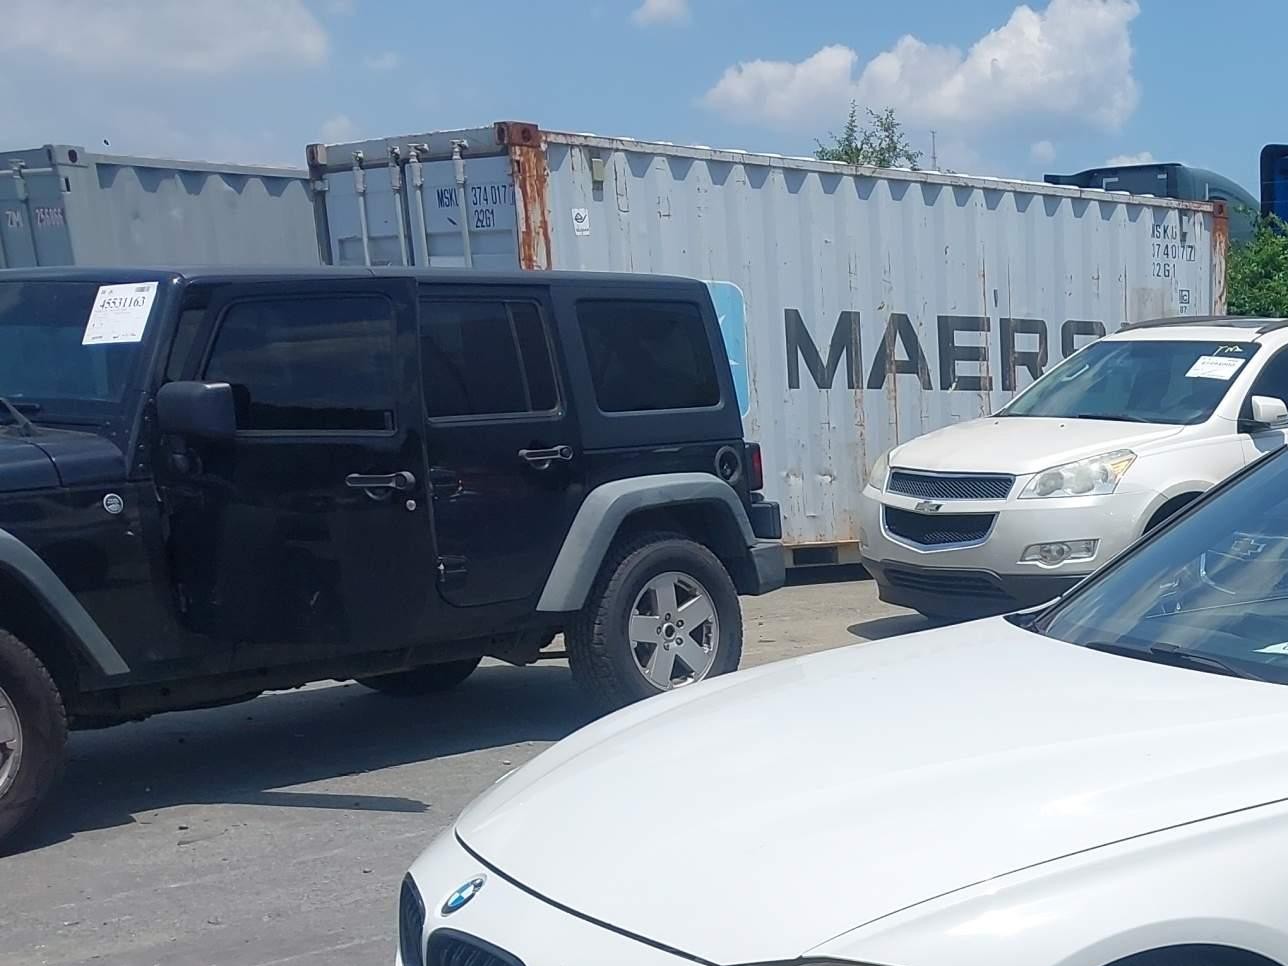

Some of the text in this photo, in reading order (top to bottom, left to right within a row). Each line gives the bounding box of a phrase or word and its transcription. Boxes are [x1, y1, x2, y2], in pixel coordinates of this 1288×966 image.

[475, 208, 495, 228] 22G1
[99, 295, 146, 310] 45531163
[784, 308, 1108, 392] MAER
